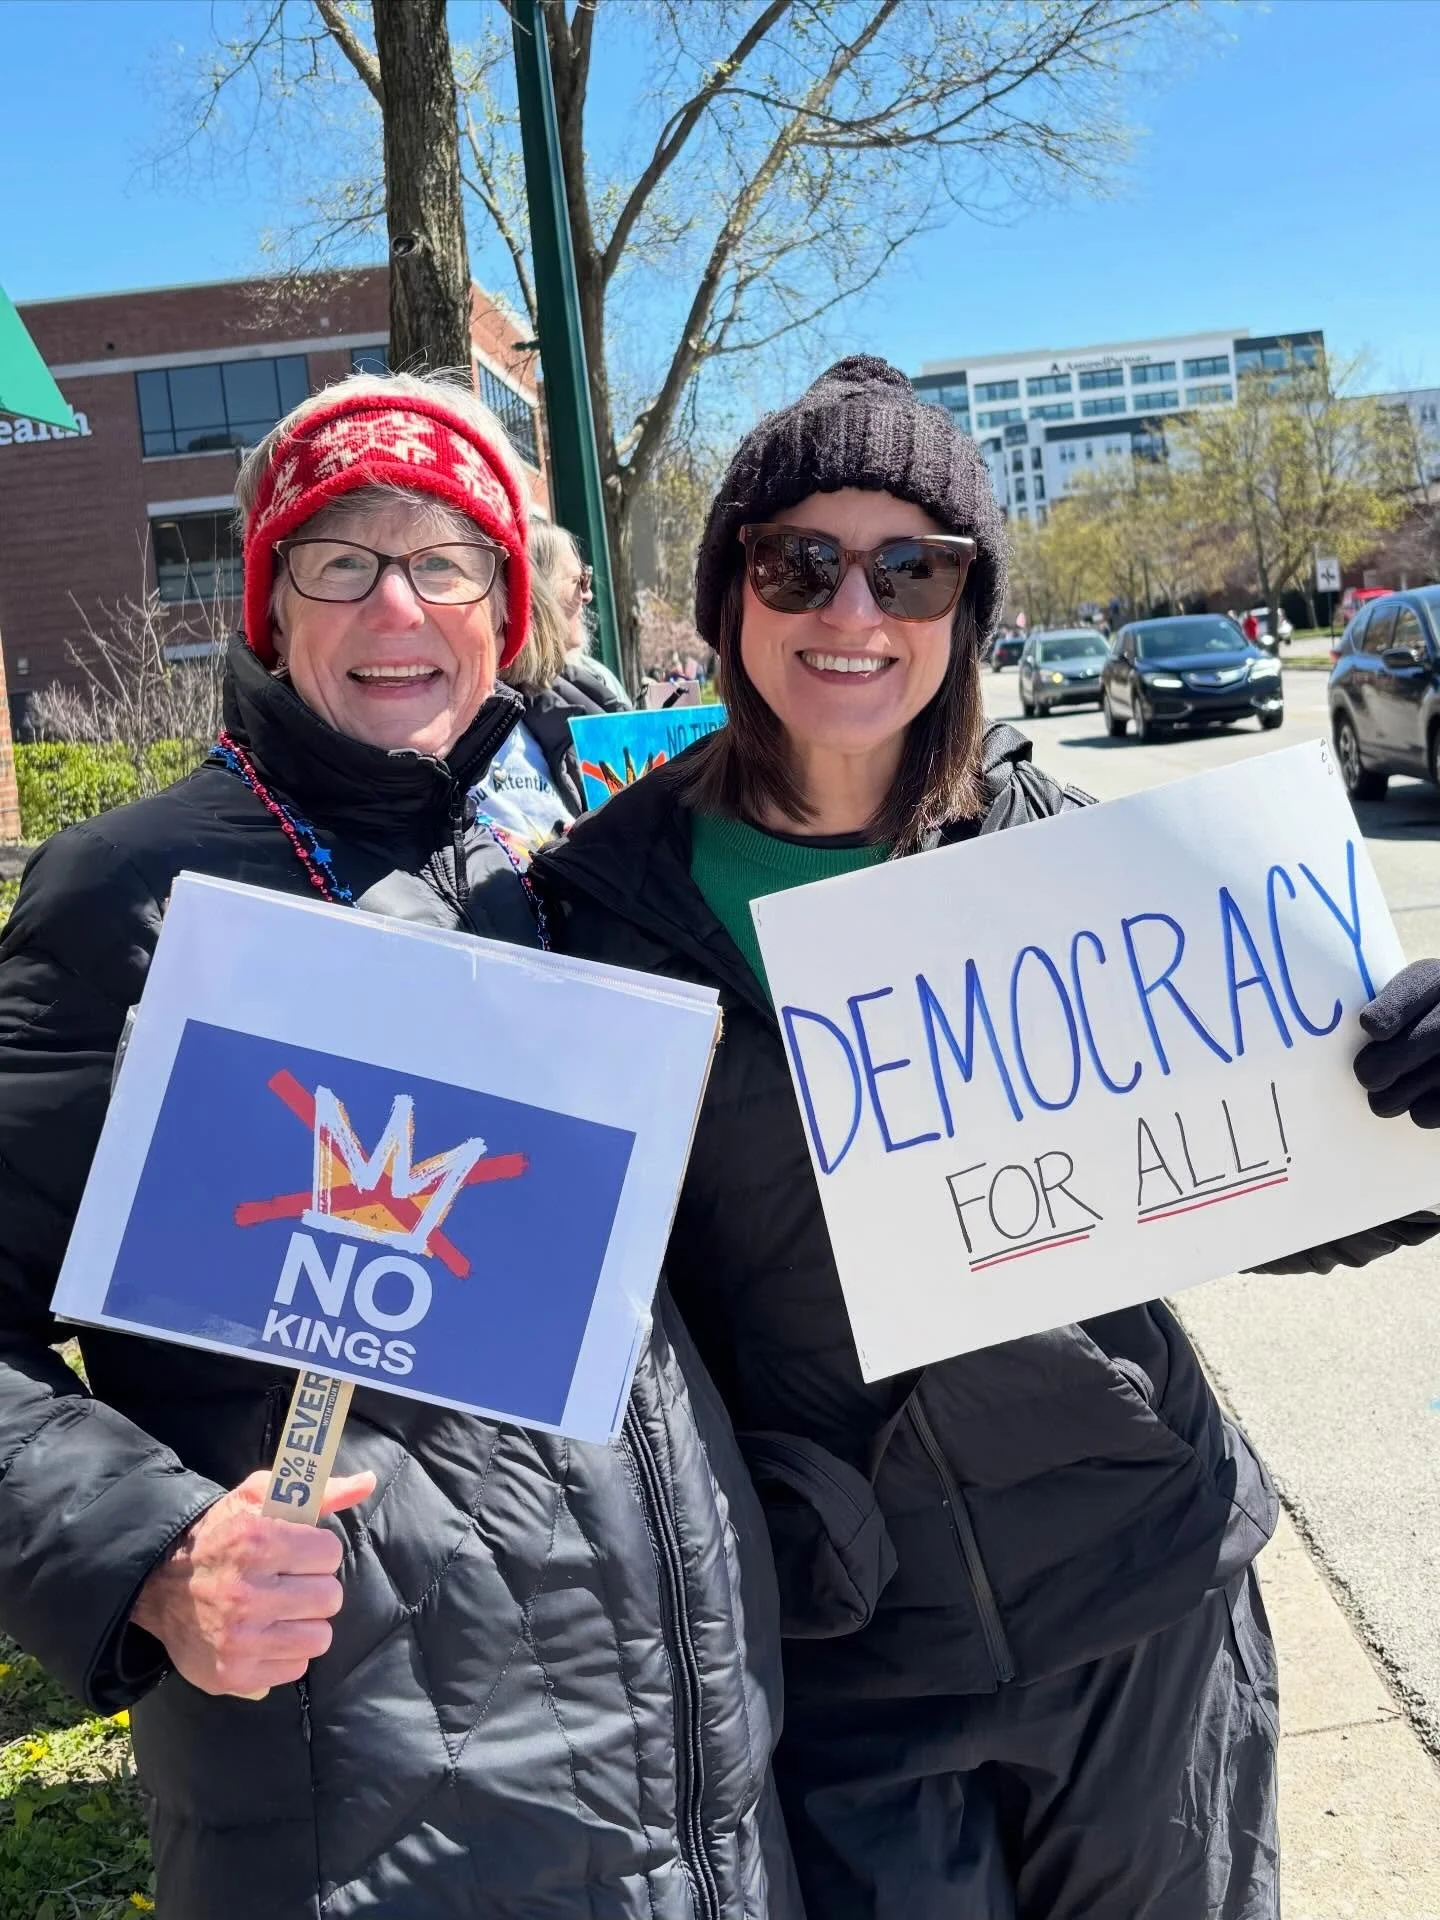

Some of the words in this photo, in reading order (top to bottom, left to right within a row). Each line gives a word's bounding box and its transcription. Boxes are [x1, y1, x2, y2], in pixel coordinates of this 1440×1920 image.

[782, 840, 1377, 1175] DEMOCRACY
[945, 1150, 1104, 1254] FOR
[1136, 1080, 1293, 1206] ALL!
[274, 1231, 433, 1332] NO
[261, 1308, 417, 1375] KINGS
[285, 1370, 332, 1453] EVER
[271, 1456, 311, 1508] 5%
[303, 1458, 318, 1483] OFF
